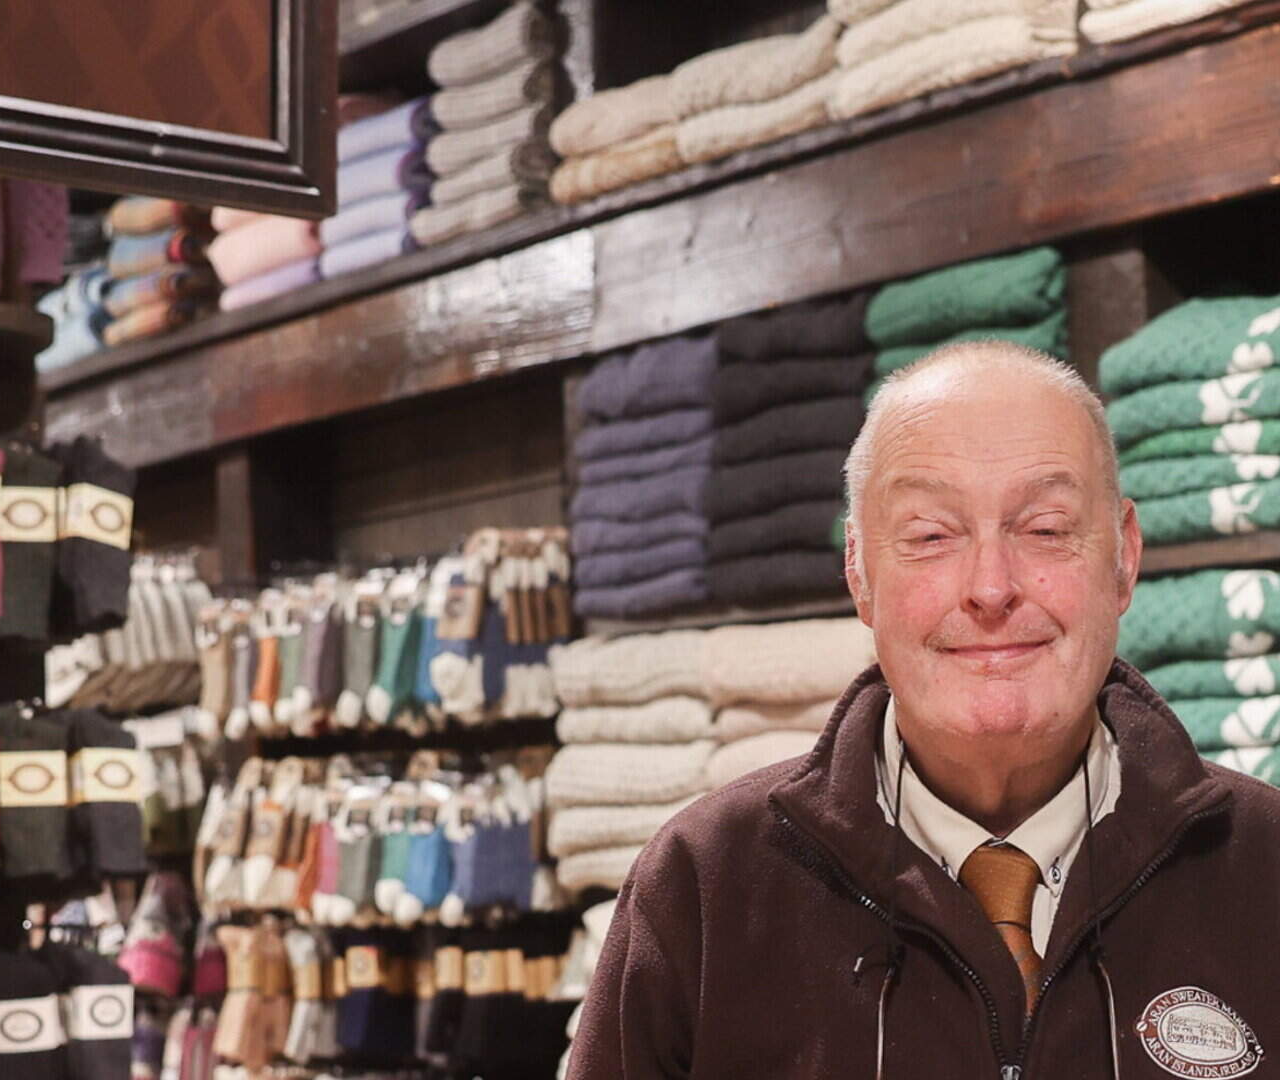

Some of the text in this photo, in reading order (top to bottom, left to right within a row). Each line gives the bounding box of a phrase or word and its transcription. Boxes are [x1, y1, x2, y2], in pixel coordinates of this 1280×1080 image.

[1148, 997, 1171, 1026] ARAN
[1171, 990, 1220, 1009] SWEATER
[1146, 1037, 1173, 1065] ARAN
[1219, 1051, 1256, 1078] IRELAND
